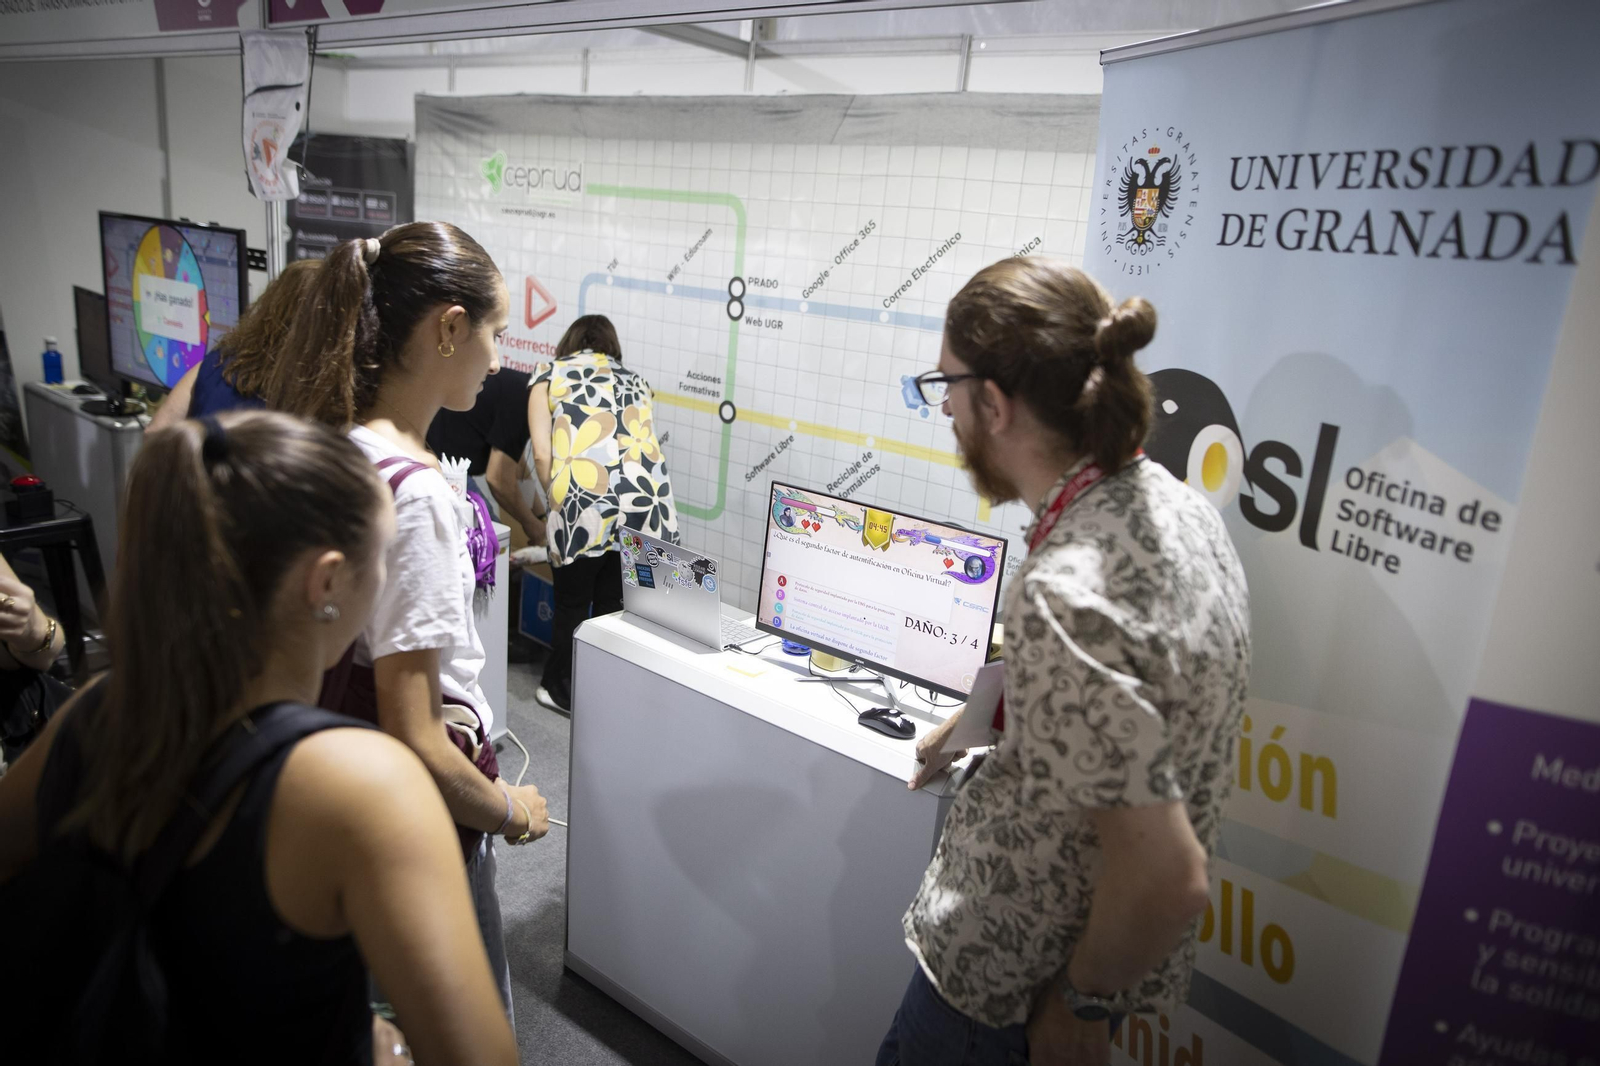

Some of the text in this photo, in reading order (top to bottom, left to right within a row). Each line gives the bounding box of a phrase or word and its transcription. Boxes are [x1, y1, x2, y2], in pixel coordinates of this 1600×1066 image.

[504, 162, 582, 195] ceprud
[1229, 138, 1600, 191] UNIVERSIDAD
[802, 270, 830, 299] Google
[834, 238, 860, 265] Office
[858, 219, 876, 240] 365
[1216, 207, 1579, 266] DE GRANADA
[748, 276, 779, 289] PRADO
[882, 232, 962, 309] Correo Electrónico
[498, 332, 557, 357] Vicerrecto
[745, 316, 784, 330] Web UGR
[679, 382, 720, 398] Formativas
[686, 370, 722, 384] Acciones
[744, 434, 795, 482] Software Libre
[826, 451, 874, 494] Reciclaje de
[838, 463, 881, 500] formáticos
[1345, 466, 1503, 533] Oficina de
[868, 522, 888, 534] 04:45
[1336, 499, 1475, 563] Software
[801, 539, 823, 551] segundo
[824, 544, 840, 556] factor
[842, 549, 848, 558] de
[901, 566, 924, 580] Oficina
[926, 573, 951, 588] Virtual?
[1330, 529, 1401, 575] Libre
[904, 616, 978, 650] DAÑO: 3 / 4
[1236, 714, 1338, 820] ión
[1531, 752, 1600, 793] Med
[1511, 818, 1600, 864] Proye
[1501, 853, 1600, 897] univer
[1488, 906, 1600, 958] Progra
